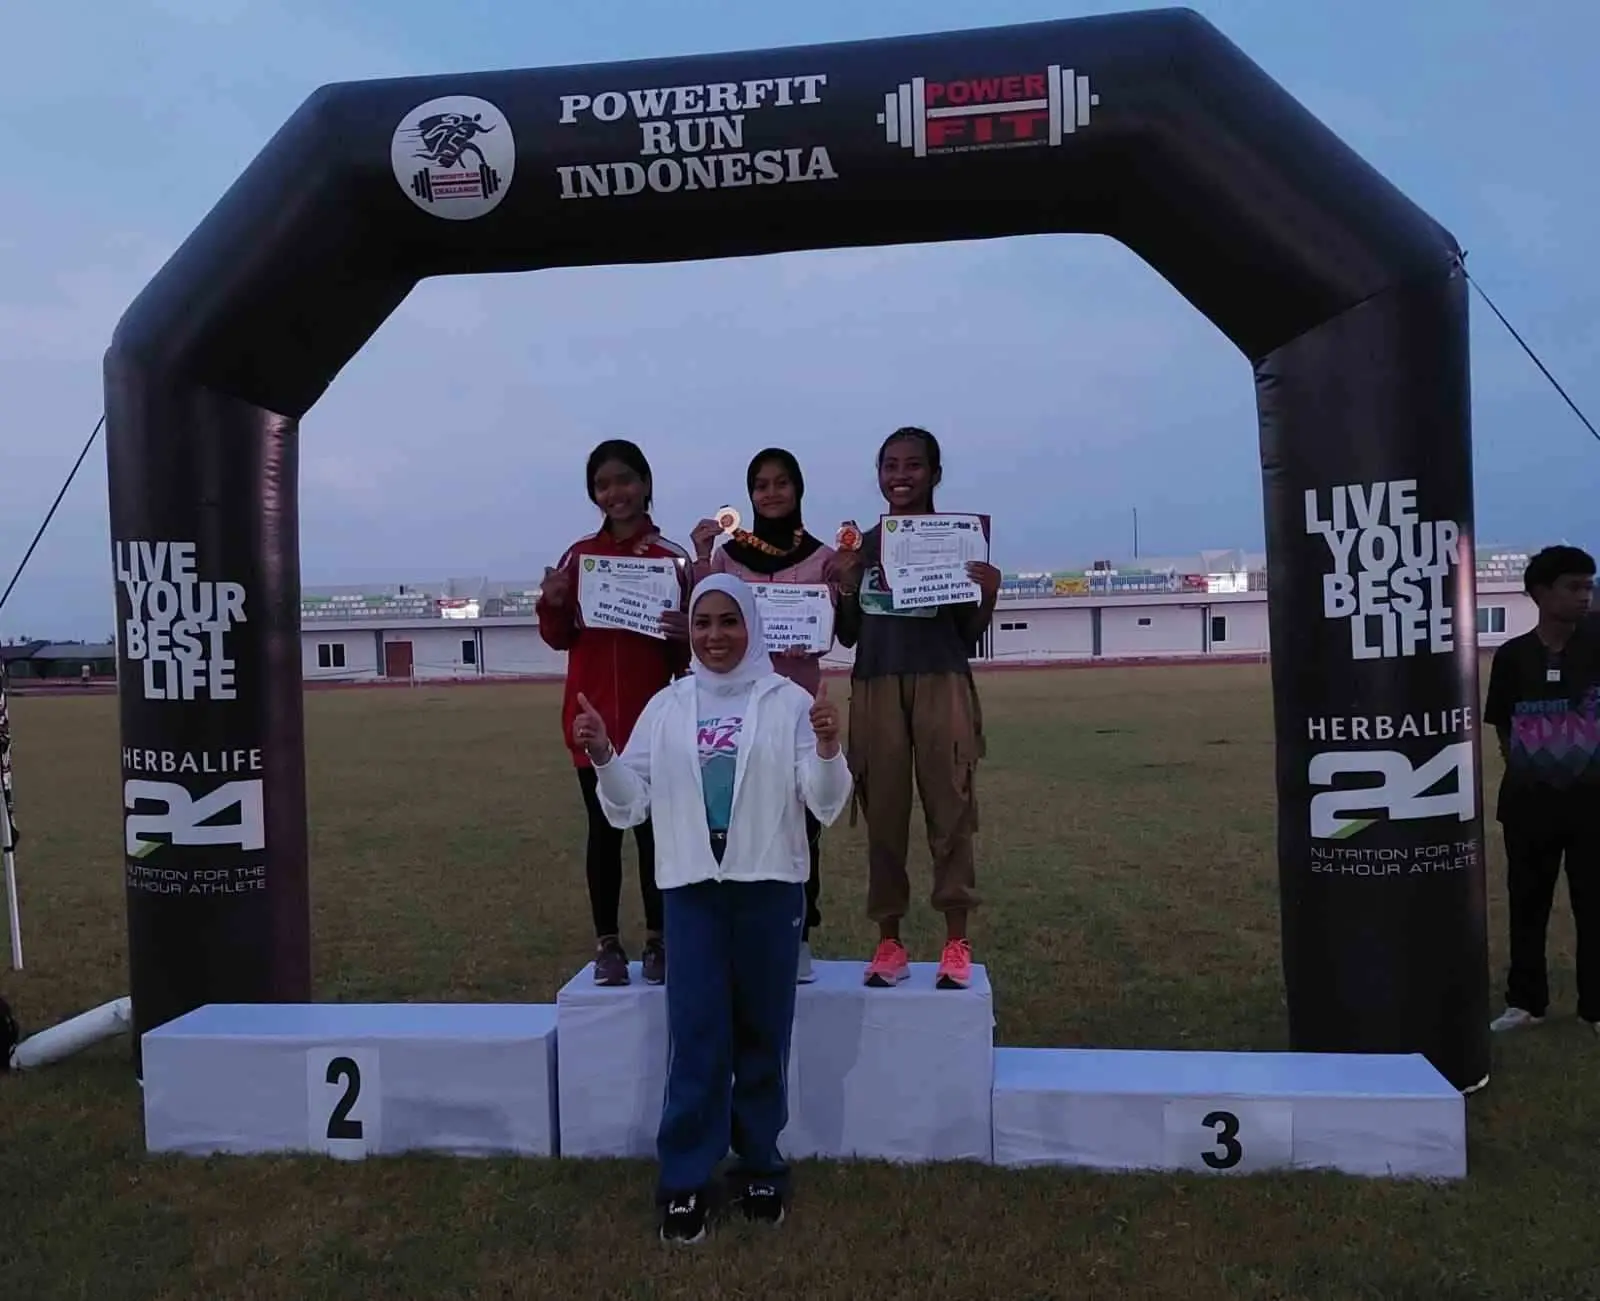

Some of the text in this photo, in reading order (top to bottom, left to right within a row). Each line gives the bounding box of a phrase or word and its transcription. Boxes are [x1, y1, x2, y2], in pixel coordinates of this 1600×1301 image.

[559, 74, 827, 124] POWERFIT
[927, 73, 1046, 106] POWER
[639, 114, 745, 156] RUN
[927, 110, 1049, 147] FIT
[557, 146, 838, 199] INDONESIA
[1305, 479, 1419, 534] LIVE
[116, 540, 198, 584] LIVE
[1322, 520, 1460, 575] YOUR
[125, 580, 247, 622] YOUR
[1323, 565, 1449, 618] BEST
[126, 619, 231, 661] BEST
[1351, 607, 1454, 660] LIFE
[143, 659, 237, 699] LIFE
[1308, 706, 1473, 741] HERBALIFE
[123, 746, 263, 773] HERBALIFE
[1308, 741, 1475, 839] 24
[125, 779, 265, 859] 24
[1311, 838, 1477, 861] NUTRITION FOR THE
[1311, 853, 1477, 876] 24-HOUR ATHLETE
[189, 878, 265, 894] ATHLETE
[194, 869, 229, 881] FOR
[235, 865, 265, 877] THE
[326, 1056, 363, 1139] 2
[1200, 1110, 1242, 1169] 3
